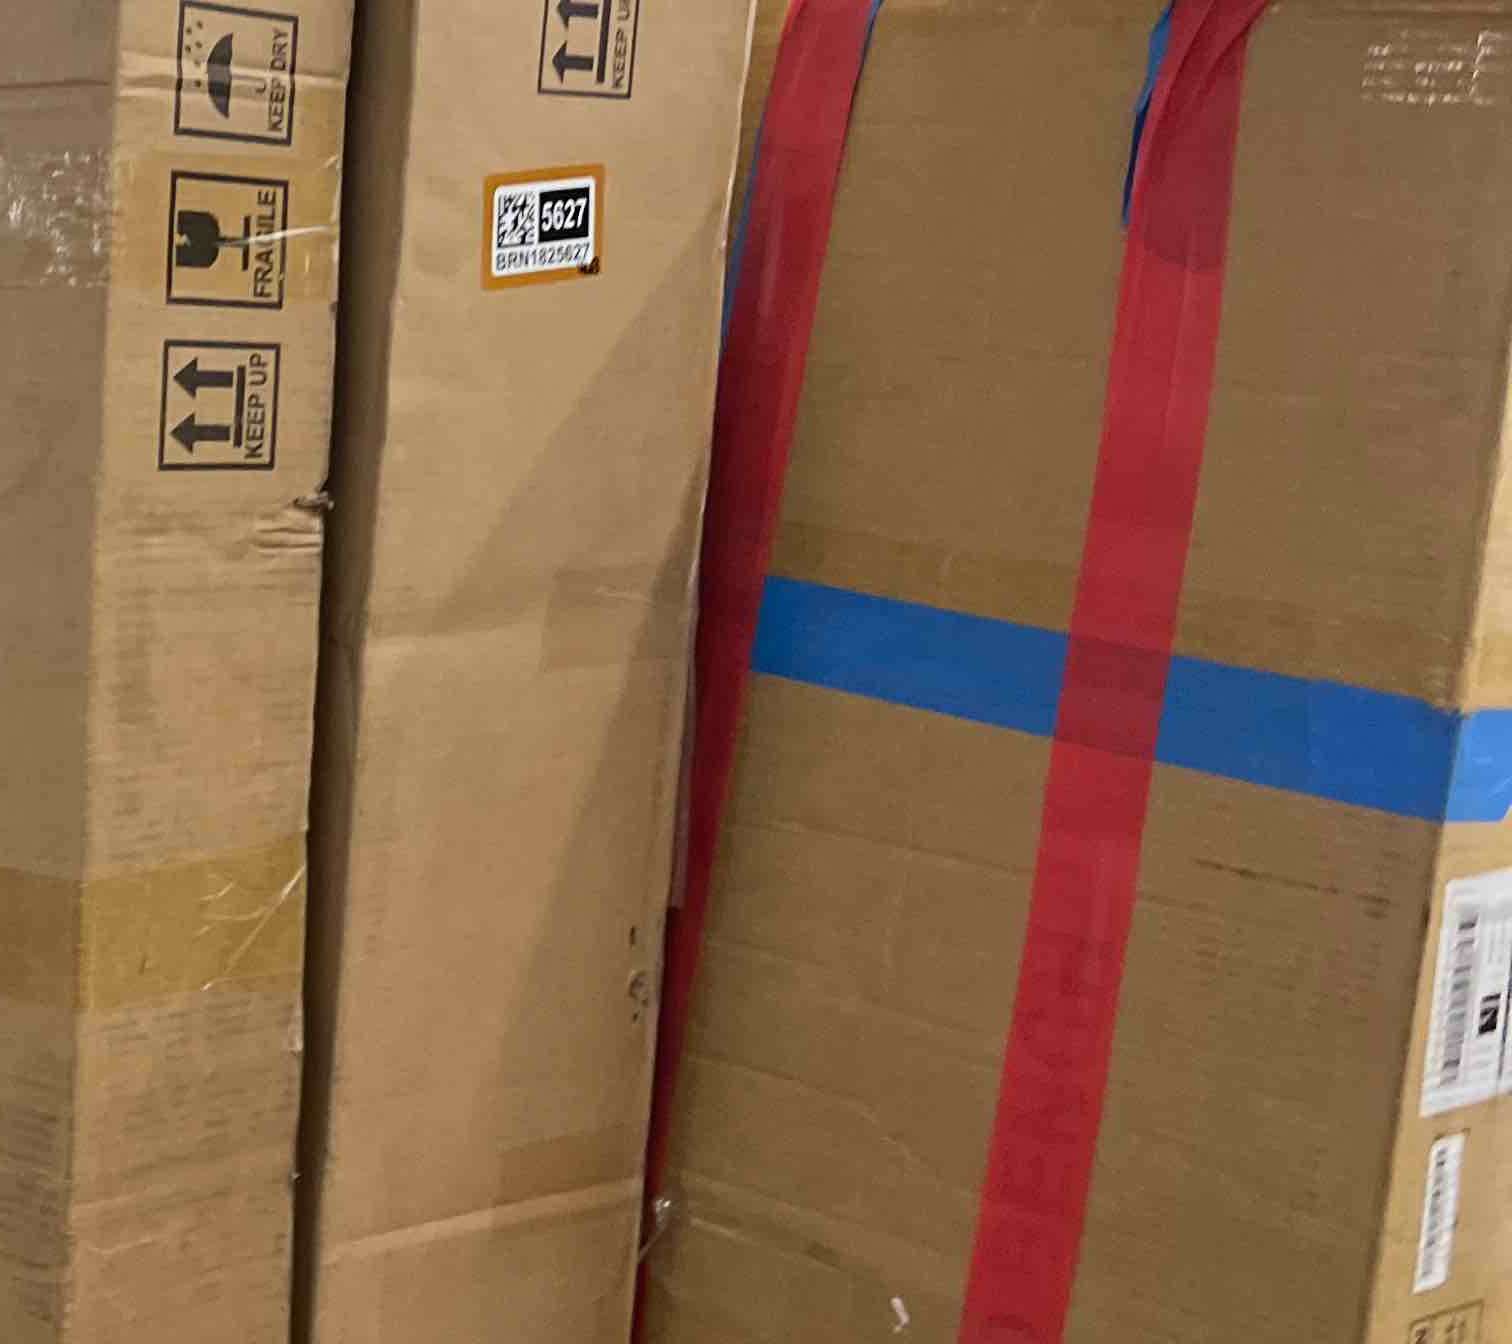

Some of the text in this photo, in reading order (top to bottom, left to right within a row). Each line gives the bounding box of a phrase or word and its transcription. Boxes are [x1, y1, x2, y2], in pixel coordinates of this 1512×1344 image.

[268, 27, 289, 131] KEEP DRY
[611, 27, 629, 89] KEEP
[253, 190, 276, 299] FRAGILE
[495, 241, 591, 271] BRN1825627
[541, 197, 588, 232] 5627
[244, 353, 269, 460] KEEP UP
